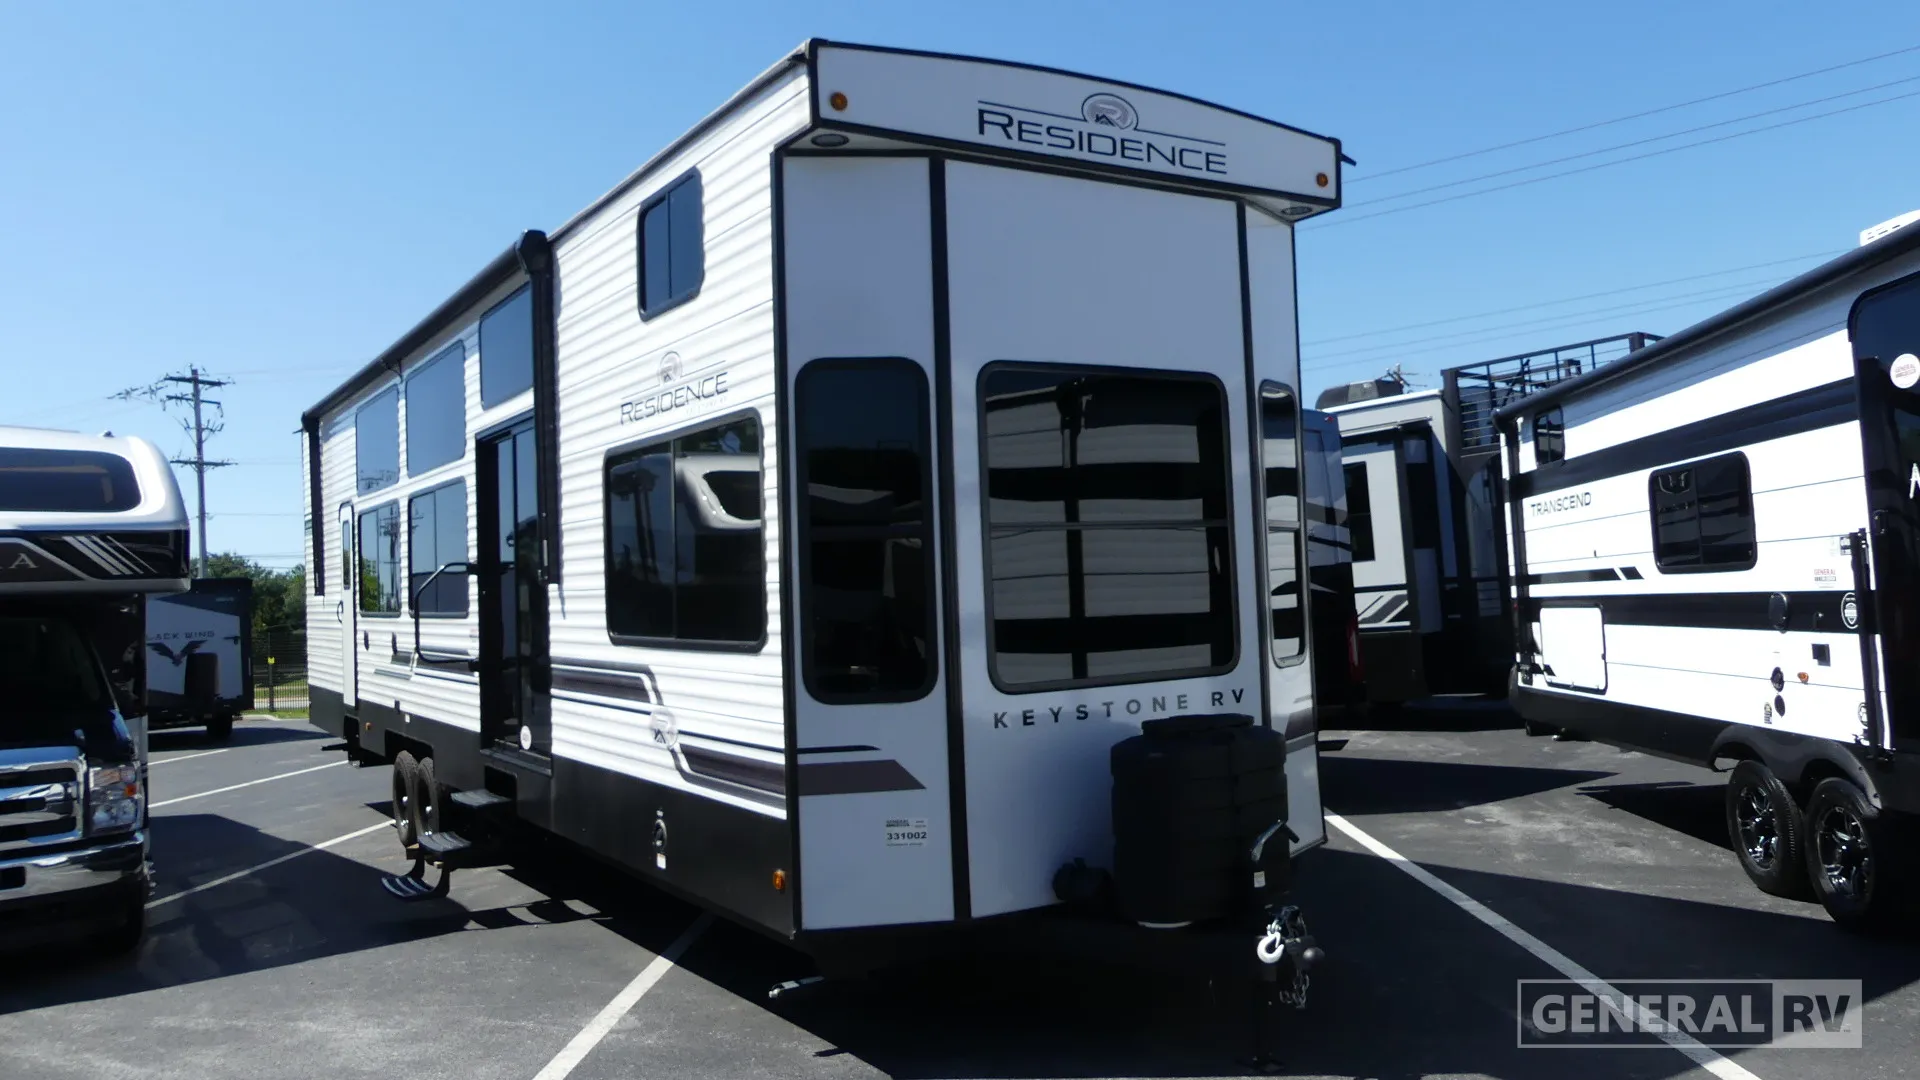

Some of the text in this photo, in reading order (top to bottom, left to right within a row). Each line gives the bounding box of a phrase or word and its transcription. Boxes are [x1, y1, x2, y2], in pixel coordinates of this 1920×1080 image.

[978, 108, 1227, 174] RESIDENCE
[620, 371, 728, 425] RESIDENCE
[1531, 491, 1591, 517] TRANSCEND
[993, 688, 1245, 729] KEYSTONE RV
[887, 831, 927, 840] 331002
